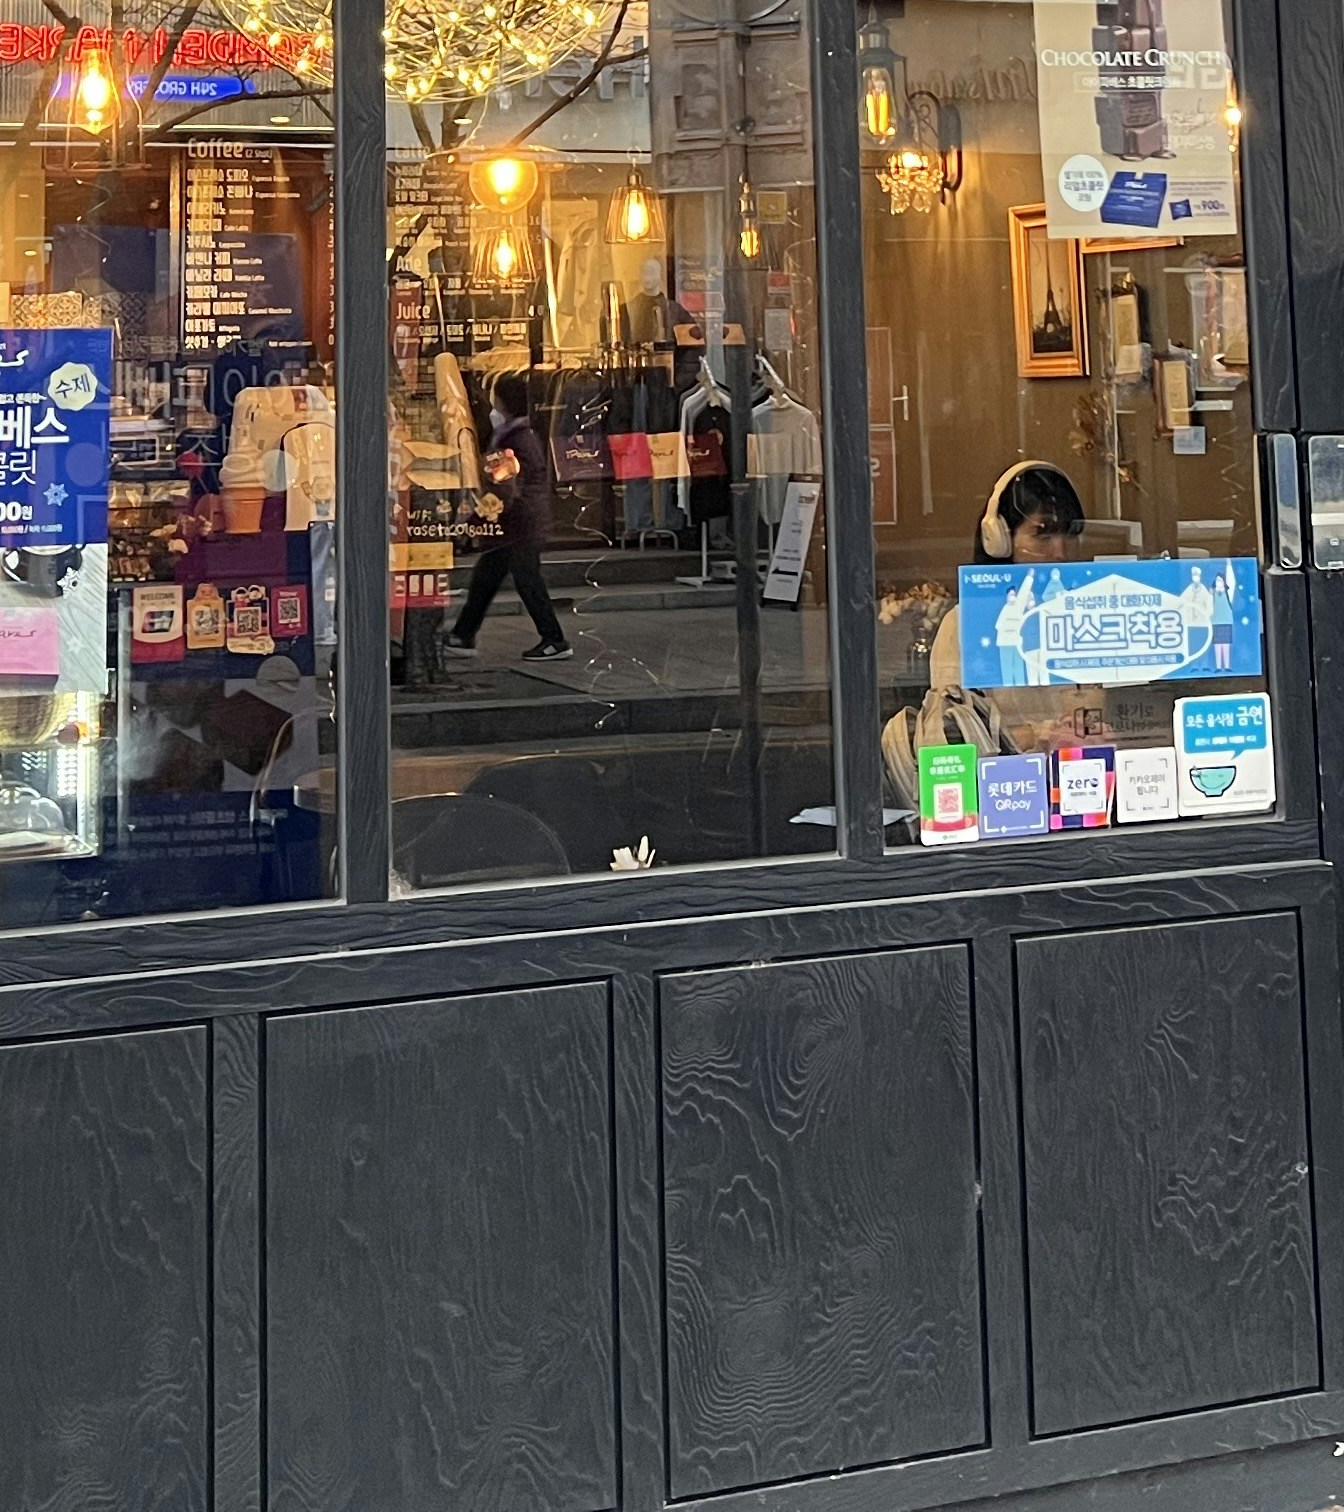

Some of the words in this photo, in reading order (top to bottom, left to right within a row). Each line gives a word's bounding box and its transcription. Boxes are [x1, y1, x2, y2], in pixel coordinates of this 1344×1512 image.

[1041, 49, 1142, 67] CHOCOLATE
[188, 138, 244, 158] Coffee
[396, 302, 431, 320] Juice
[55, 373, 90, 399] 수제
[1185, 714, 1204, 728] 모든
[1207, 712, 1234, 728] 음식점
[1236, 705, 1263, 726] 금연
[987, 780, 1038, 797] 롯데카드
[1067, 778, 1099, 790] zero
